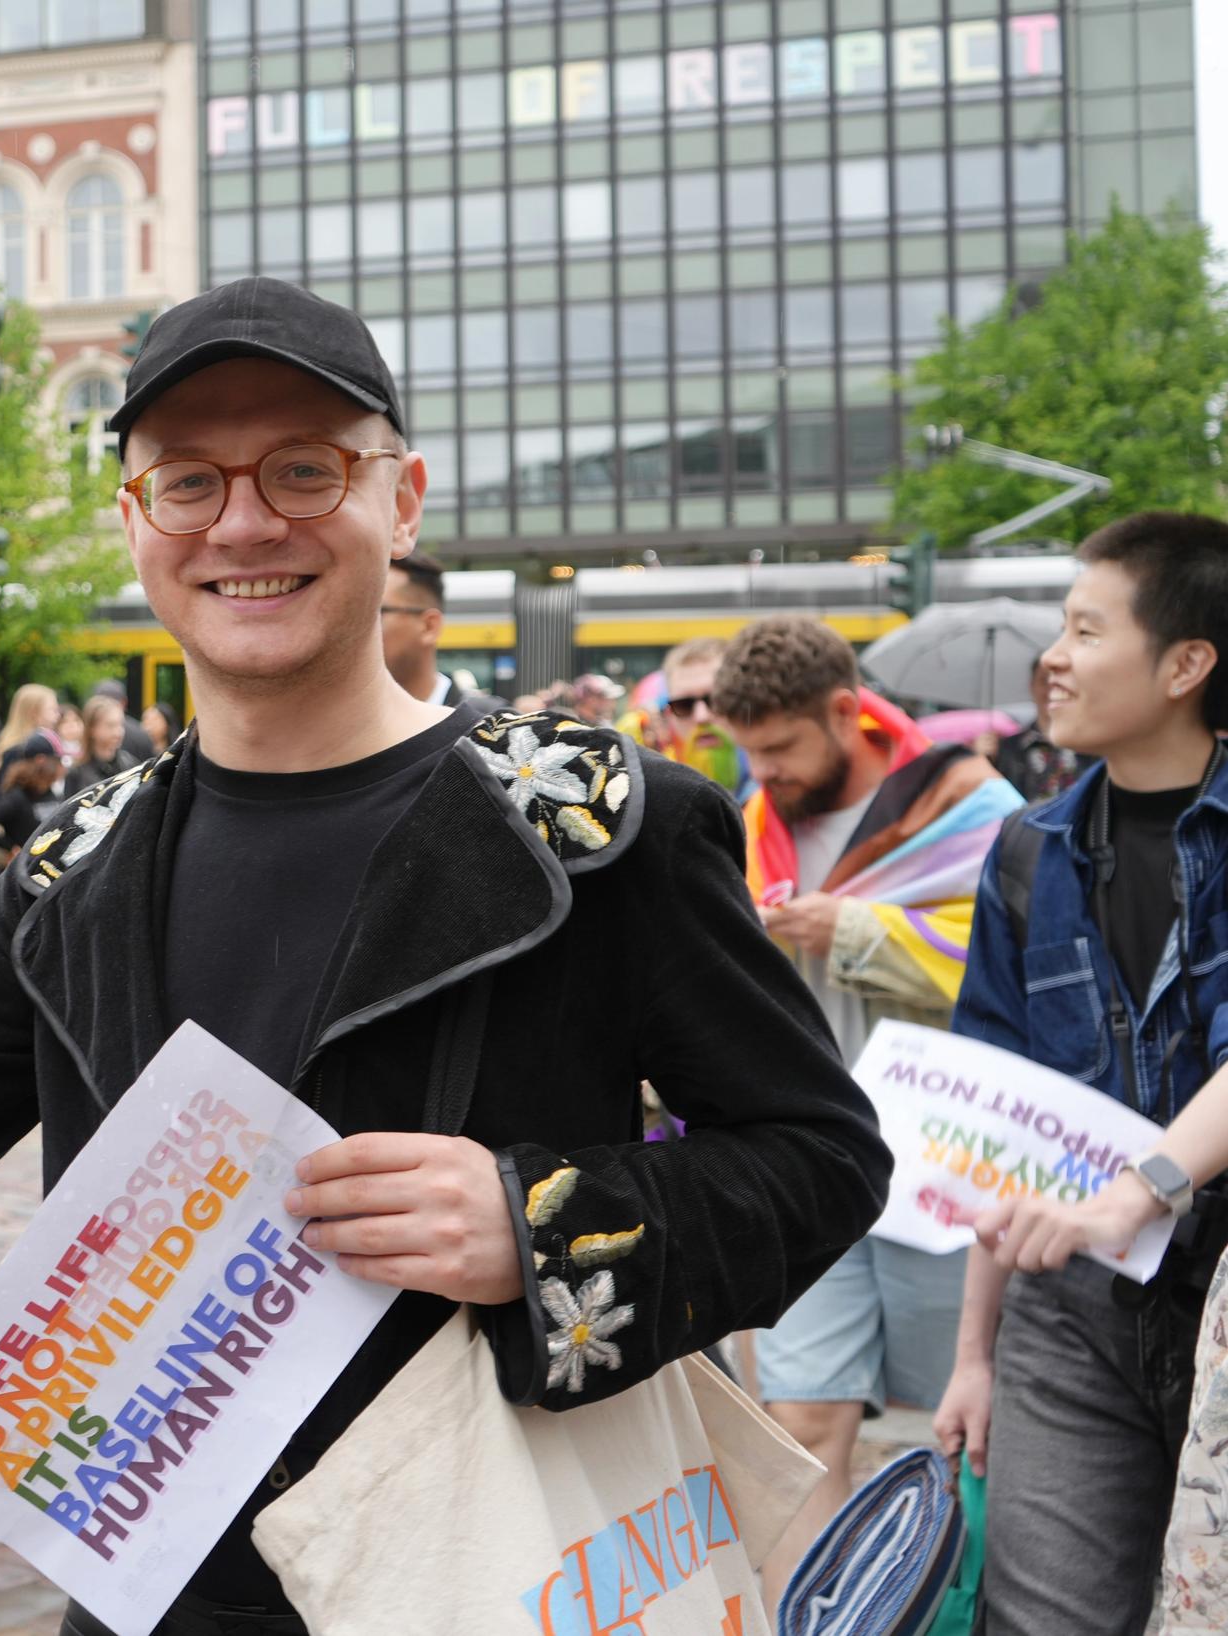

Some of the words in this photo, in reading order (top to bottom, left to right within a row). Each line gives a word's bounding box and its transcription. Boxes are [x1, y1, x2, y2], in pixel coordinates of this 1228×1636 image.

[208, 83, 401, 157] FULL
[508, 61, 606, 126] OF
[669, 13, 1060, 110] RESPECT
[883, 1059, 980, 1104] NOW
[921, 1114, 1007, 1161] AND
[16, 1155, 251, 1449] PRIVILEDGE
[24, 1214, 122, 1323] LIFE
[45, 1292, 240, 1536] BASELINE
[224, 1217, 284, 1297] OF
[78, 1366, 234, 1562] HUMAN
[213, 1217, 326, 1375] RIGH
[12, 1451, 68, 1512] IT
[53, 1405, 109, 1461] IS
